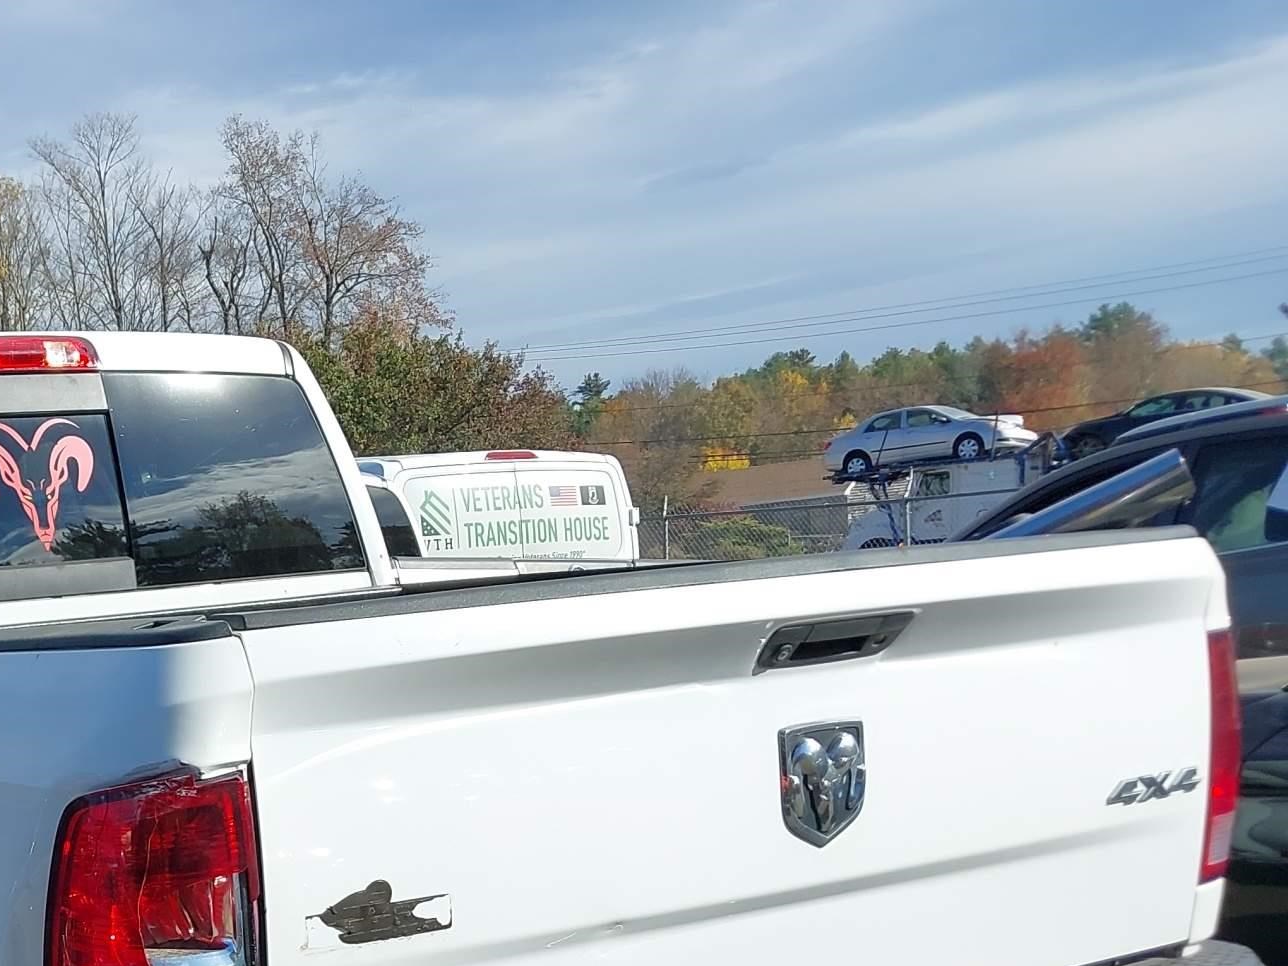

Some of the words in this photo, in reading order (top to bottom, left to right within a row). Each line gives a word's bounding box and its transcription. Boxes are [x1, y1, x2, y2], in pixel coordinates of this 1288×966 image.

[461, 485, 543, 512] VETERANS
[464, 519, 558, 548] TRANSITION
[564, 516, 610, 542] HOUSE
